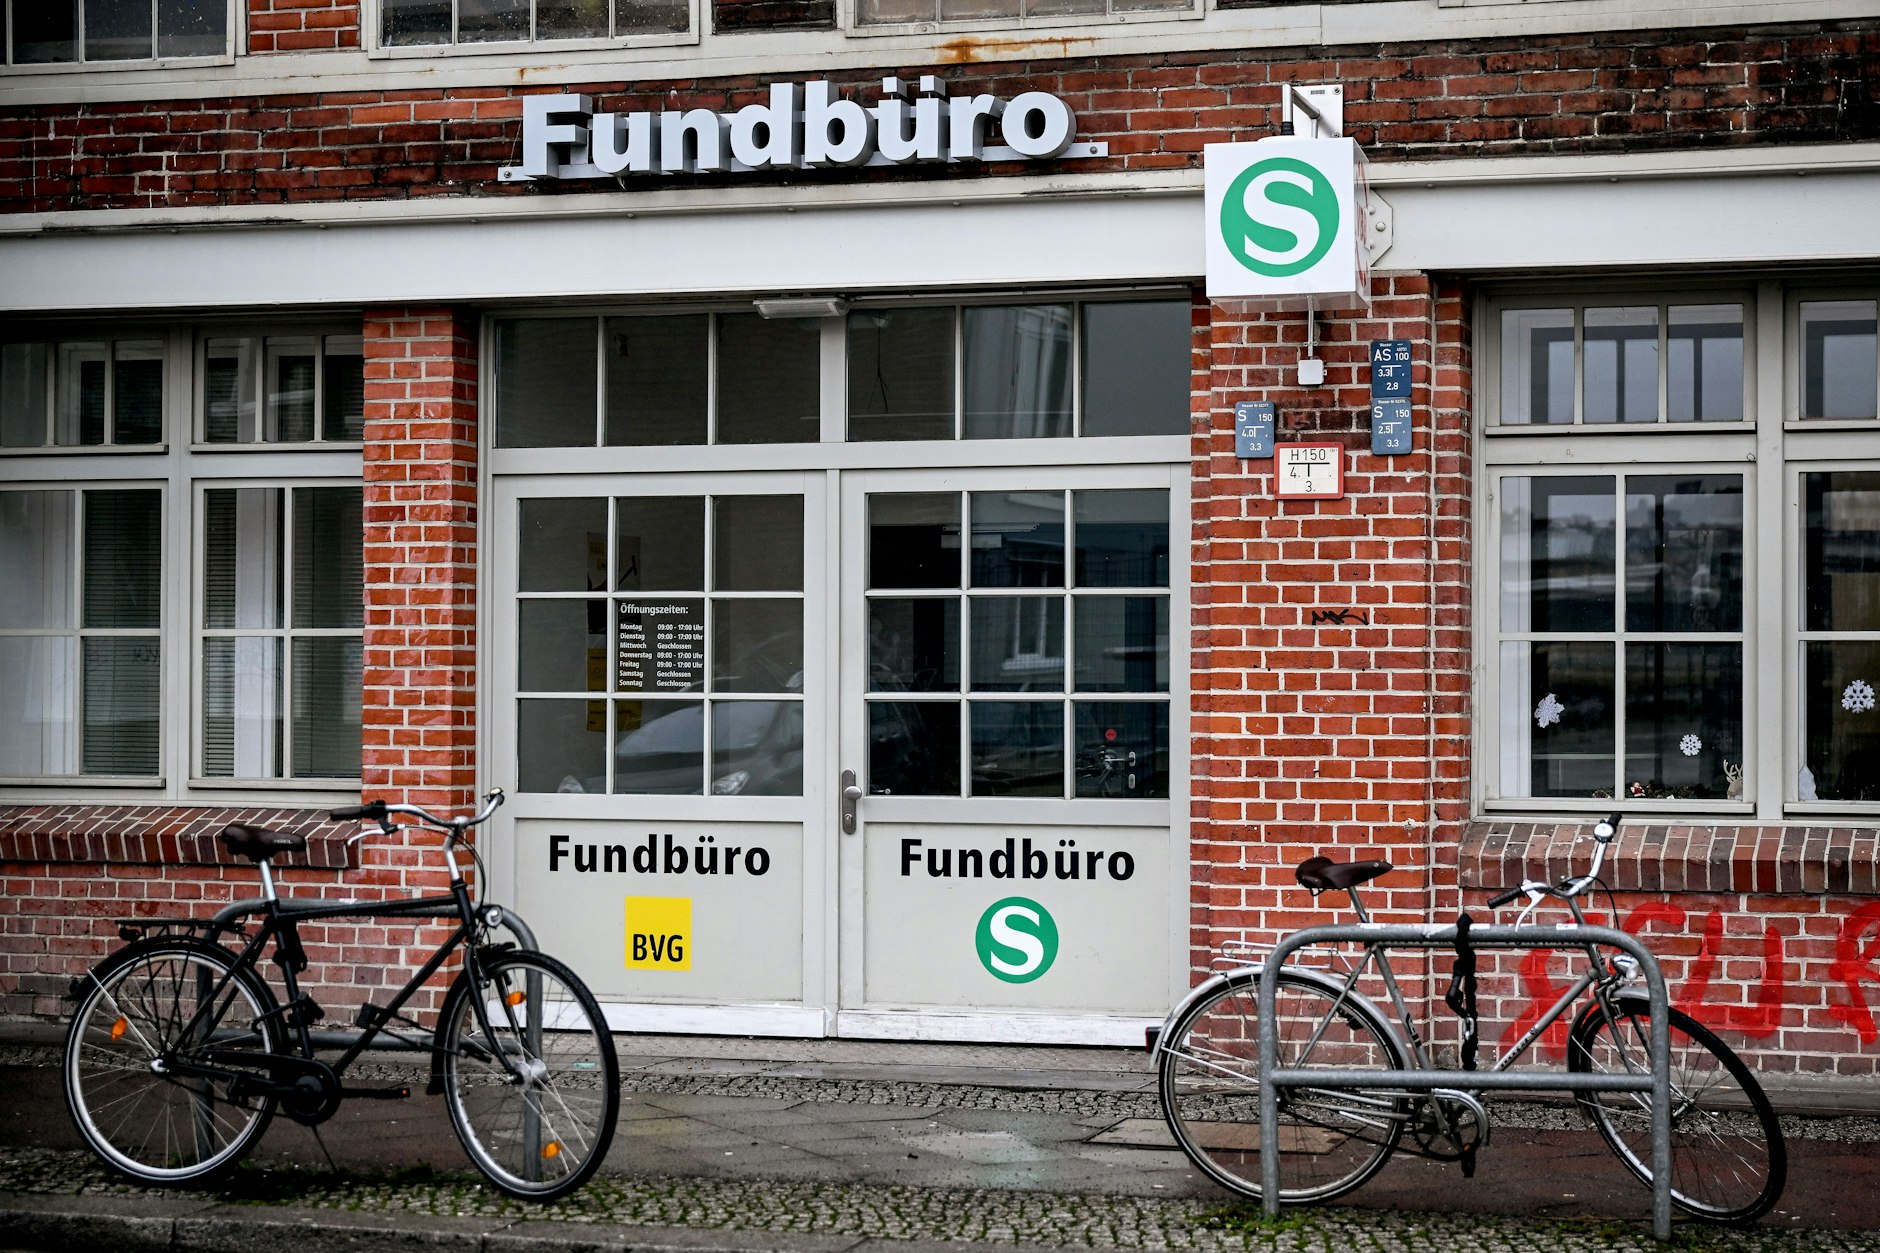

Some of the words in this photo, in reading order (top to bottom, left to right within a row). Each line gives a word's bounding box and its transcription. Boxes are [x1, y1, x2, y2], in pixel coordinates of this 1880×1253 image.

[522, 75, 1076, 179] Fundbüro
[1243, 169, 1320, 265] S
[1374, 349, 1391, 362] AS
[1394, 352, 1410, 361] 100
[1237, 409, 1247, 422] S
[1258, 413, 1273, 422] 150
[1373, 405, 1383, 418] S
[1395, 409, 1410, 418] 150
[620, 603, 689, 616] Öffnungszeiten:
[620, 623, 643, 631] Montag
[620, 632, 646, 640] Dienstag
[619, 651, 653, 659] Donnerstag
[619, 670, 644, 678] Samstag
[656, 670, 692, 678] Geschlossen
[619, 679, 643, 687] Sonntag
[656, 679, 692, 687] Geschlossen
[549, 833, 771, 876] Fundbüro
[900, 837, 1135, 881] Fundbüro
[989, 905, 1045, 976] S
[632, 933, 684, 963] BVG
